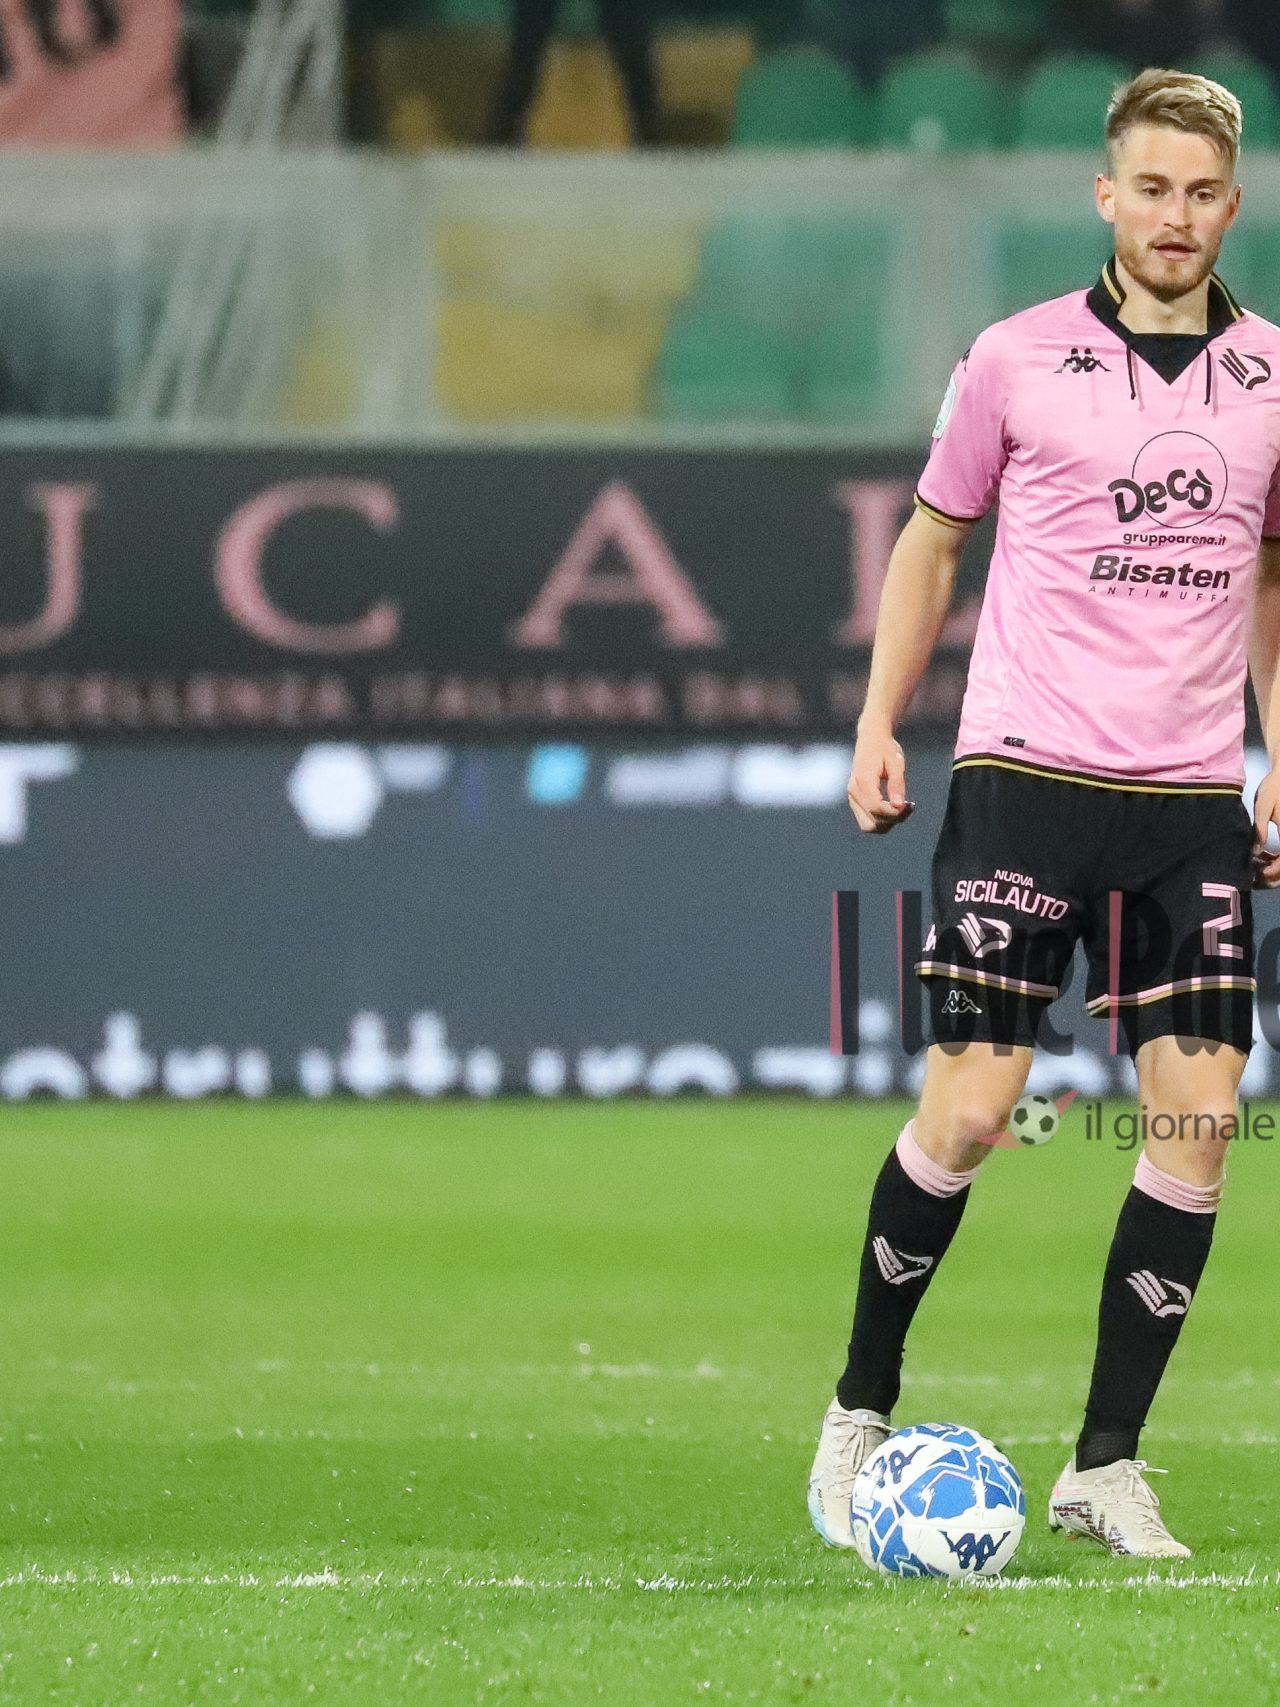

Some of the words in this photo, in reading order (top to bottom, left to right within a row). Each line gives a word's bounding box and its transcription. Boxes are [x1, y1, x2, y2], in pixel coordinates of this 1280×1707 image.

[1122, 532, 1227, 547] gruppoarena.it
[1089, 554, 1231, 590] Bisaten
[1088, 585, 1229, 603] ANTIMUFFA
[994, 869, 1034, 889] NUOVA
[954, 880, 1069, 920] SICILAUTO
[1202, 882, 1244, 960] 2
